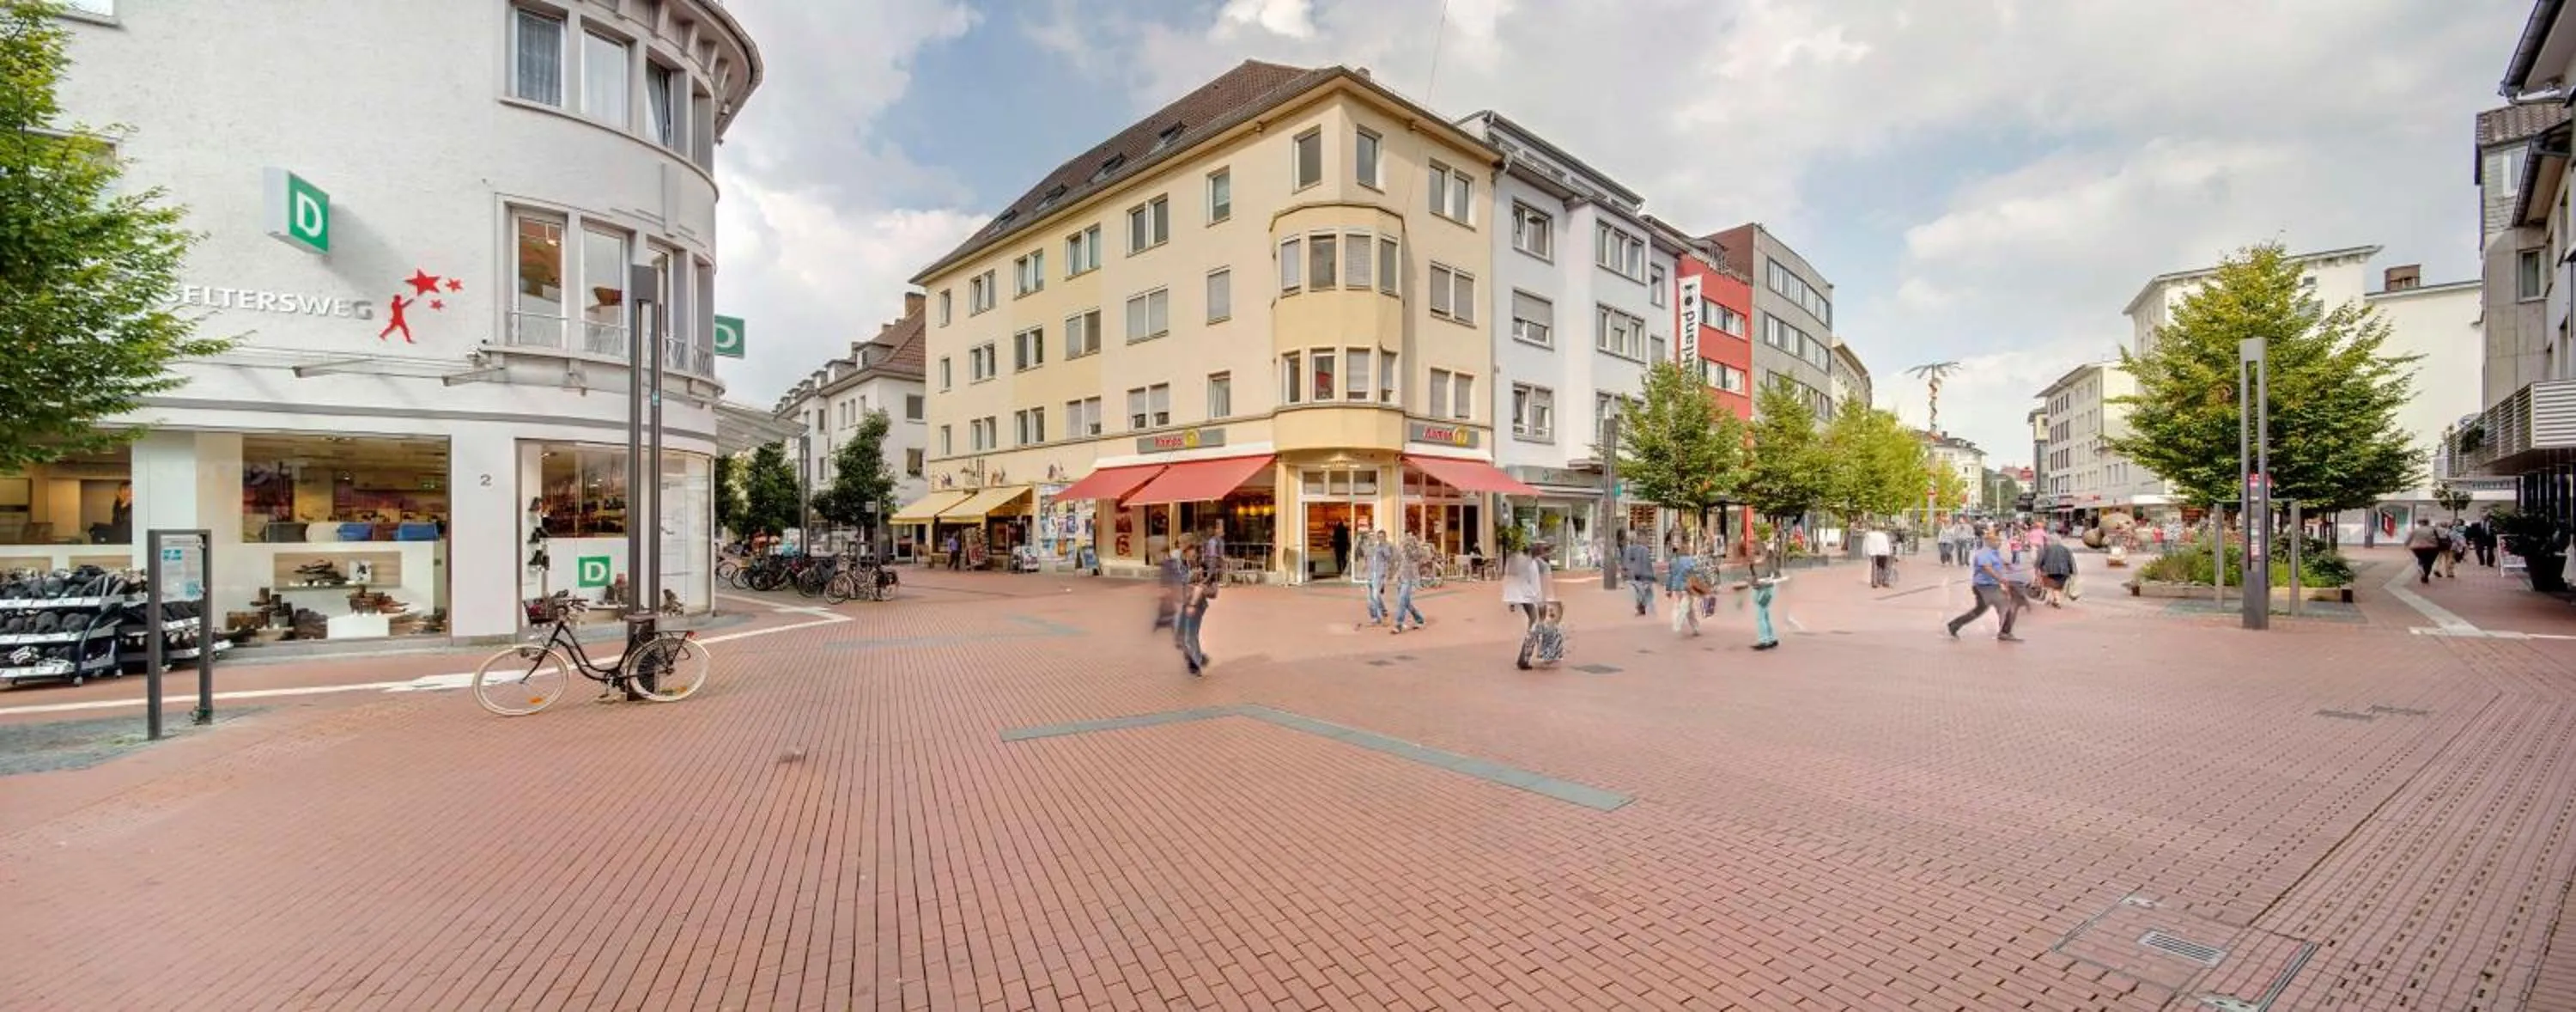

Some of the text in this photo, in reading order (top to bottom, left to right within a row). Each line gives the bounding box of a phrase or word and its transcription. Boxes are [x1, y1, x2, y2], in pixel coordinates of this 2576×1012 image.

[296, 191, 323, 237] D
[480, 473, 491, 486] 2
[584, 562, 606, 582] D
